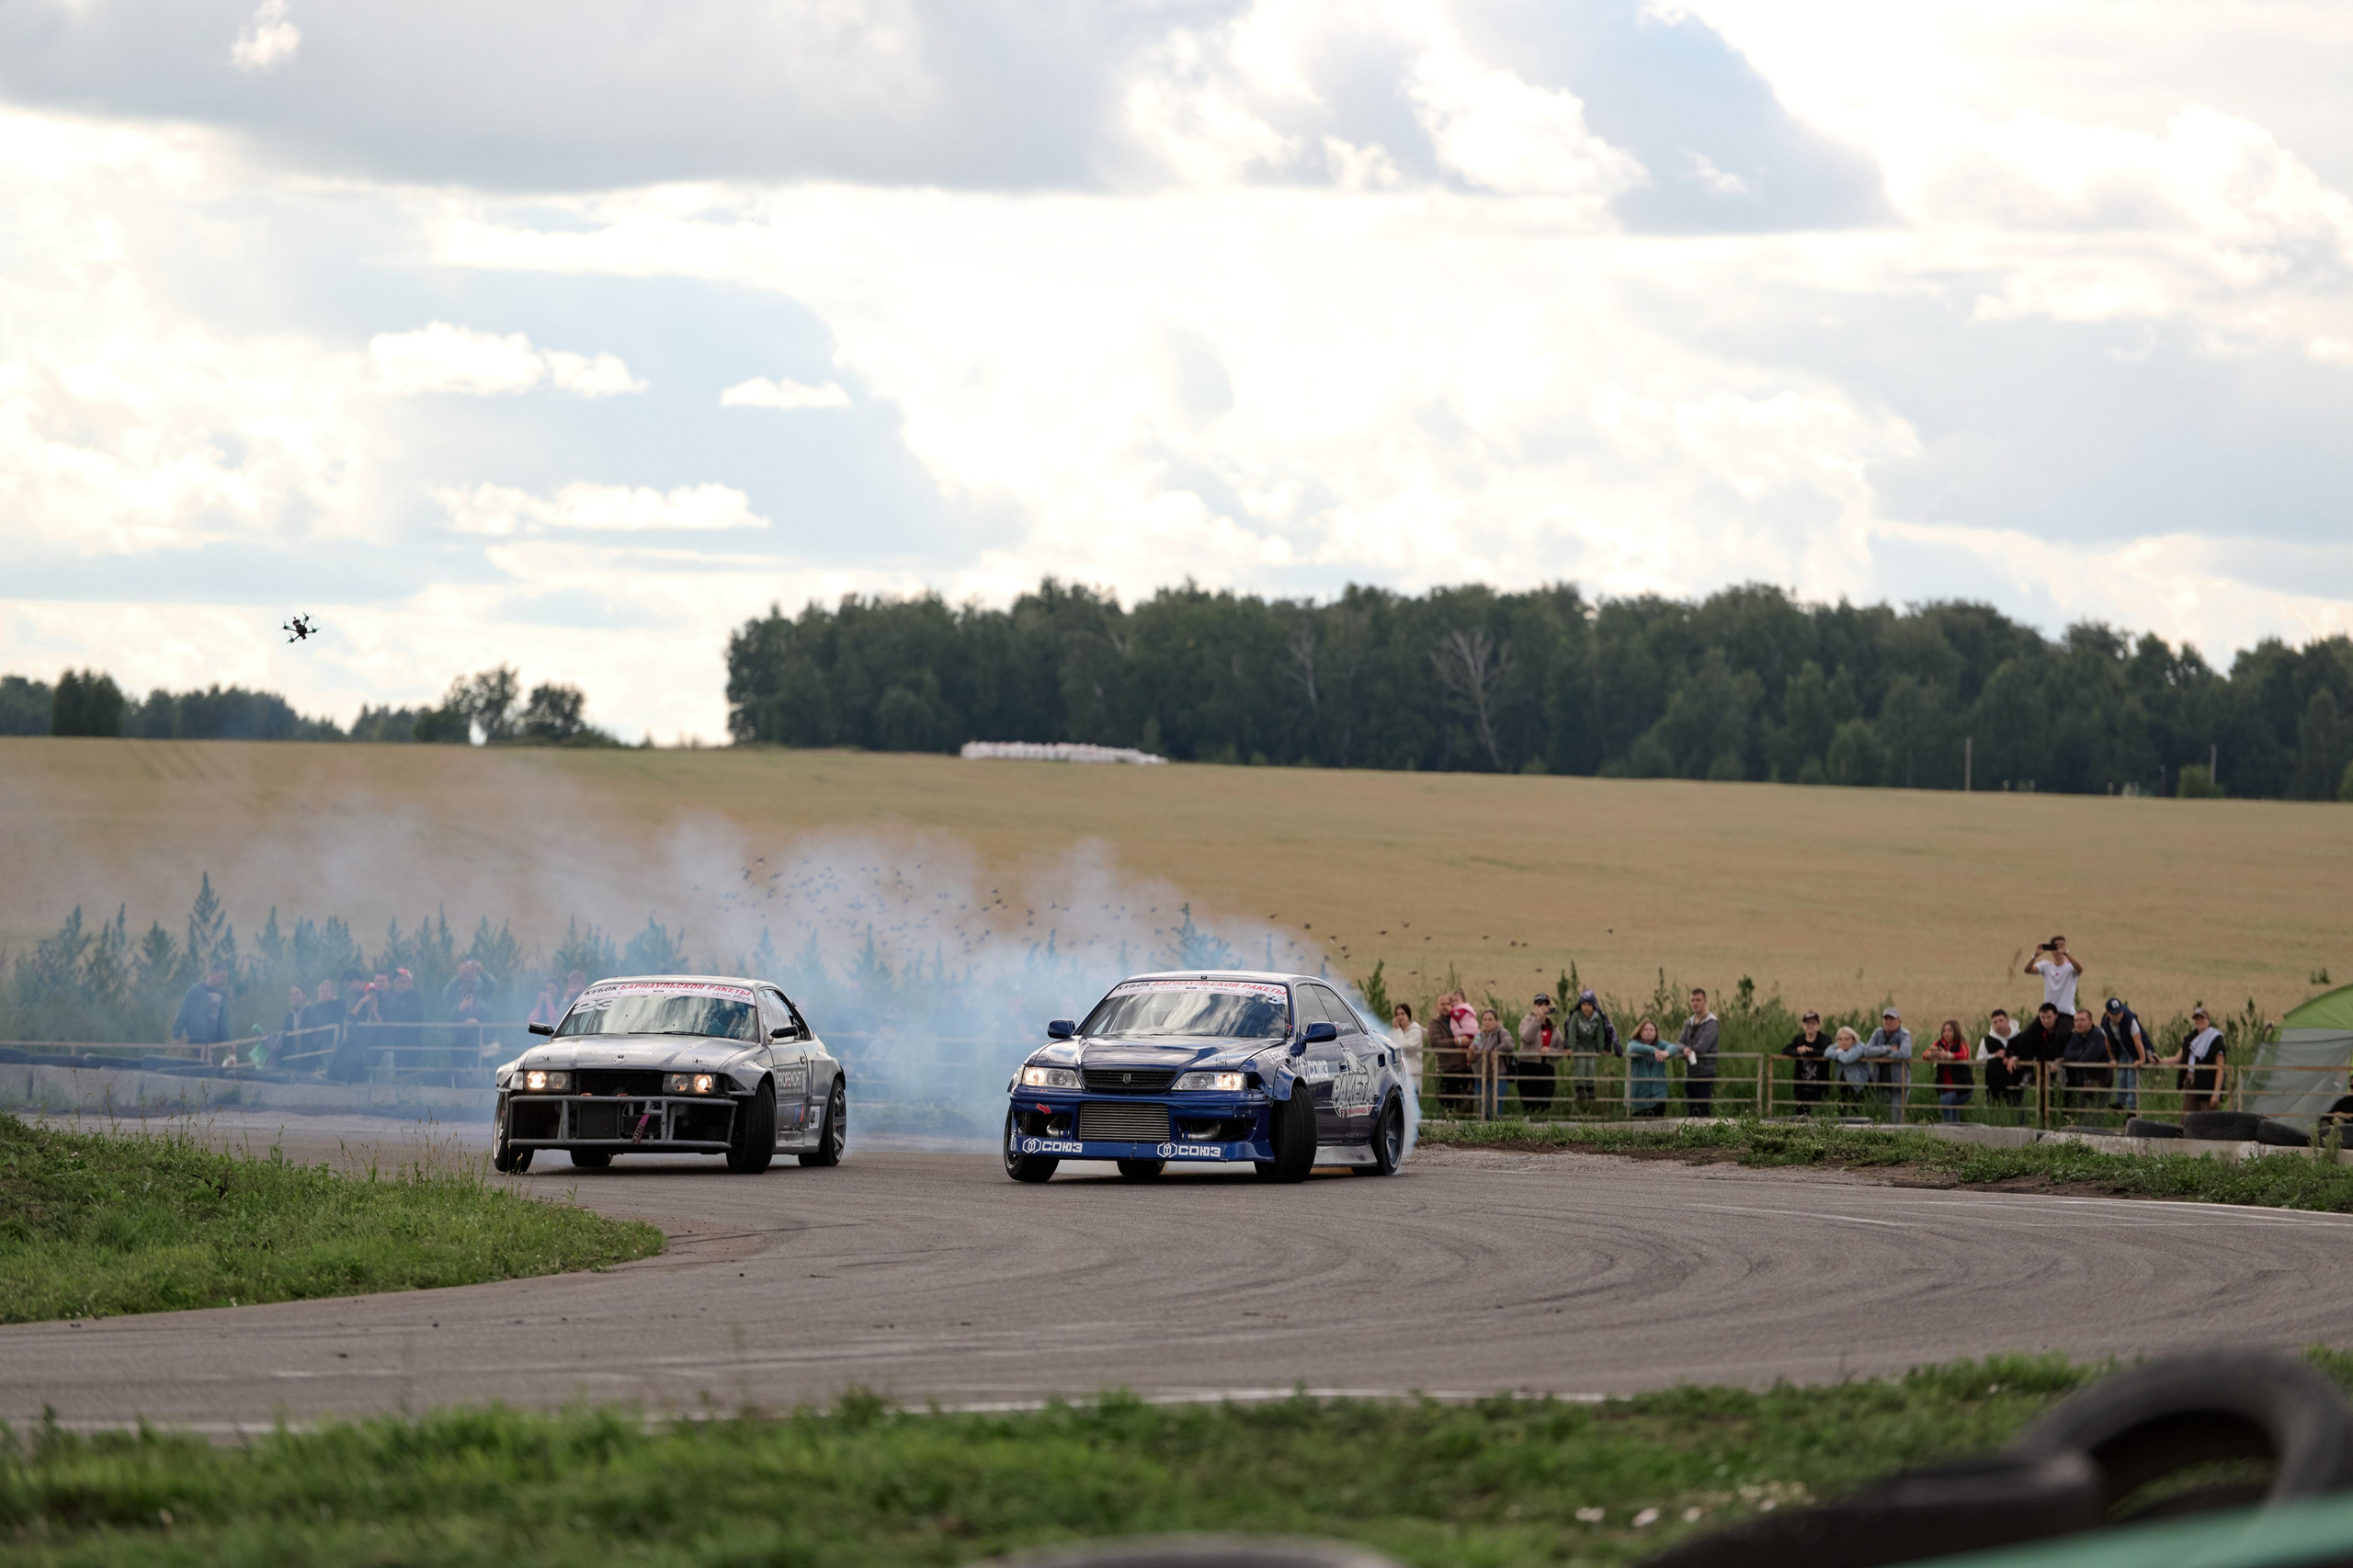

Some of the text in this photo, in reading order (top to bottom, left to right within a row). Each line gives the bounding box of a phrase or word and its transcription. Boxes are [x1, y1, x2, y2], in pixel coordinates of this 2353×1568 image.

[584, 985, 618, 995] КУБОК
[708, 984, 751, 996] РАКЕТЫ
[1242, 983, 1287, 995] РАКЕТЫ
[1332, 1073, 1374, 1107] РАКЕТА
[1041, 1141, 1083, 1153] СОЮЗ
[1178, 1145, 1221, 1157] СОЮЗ
